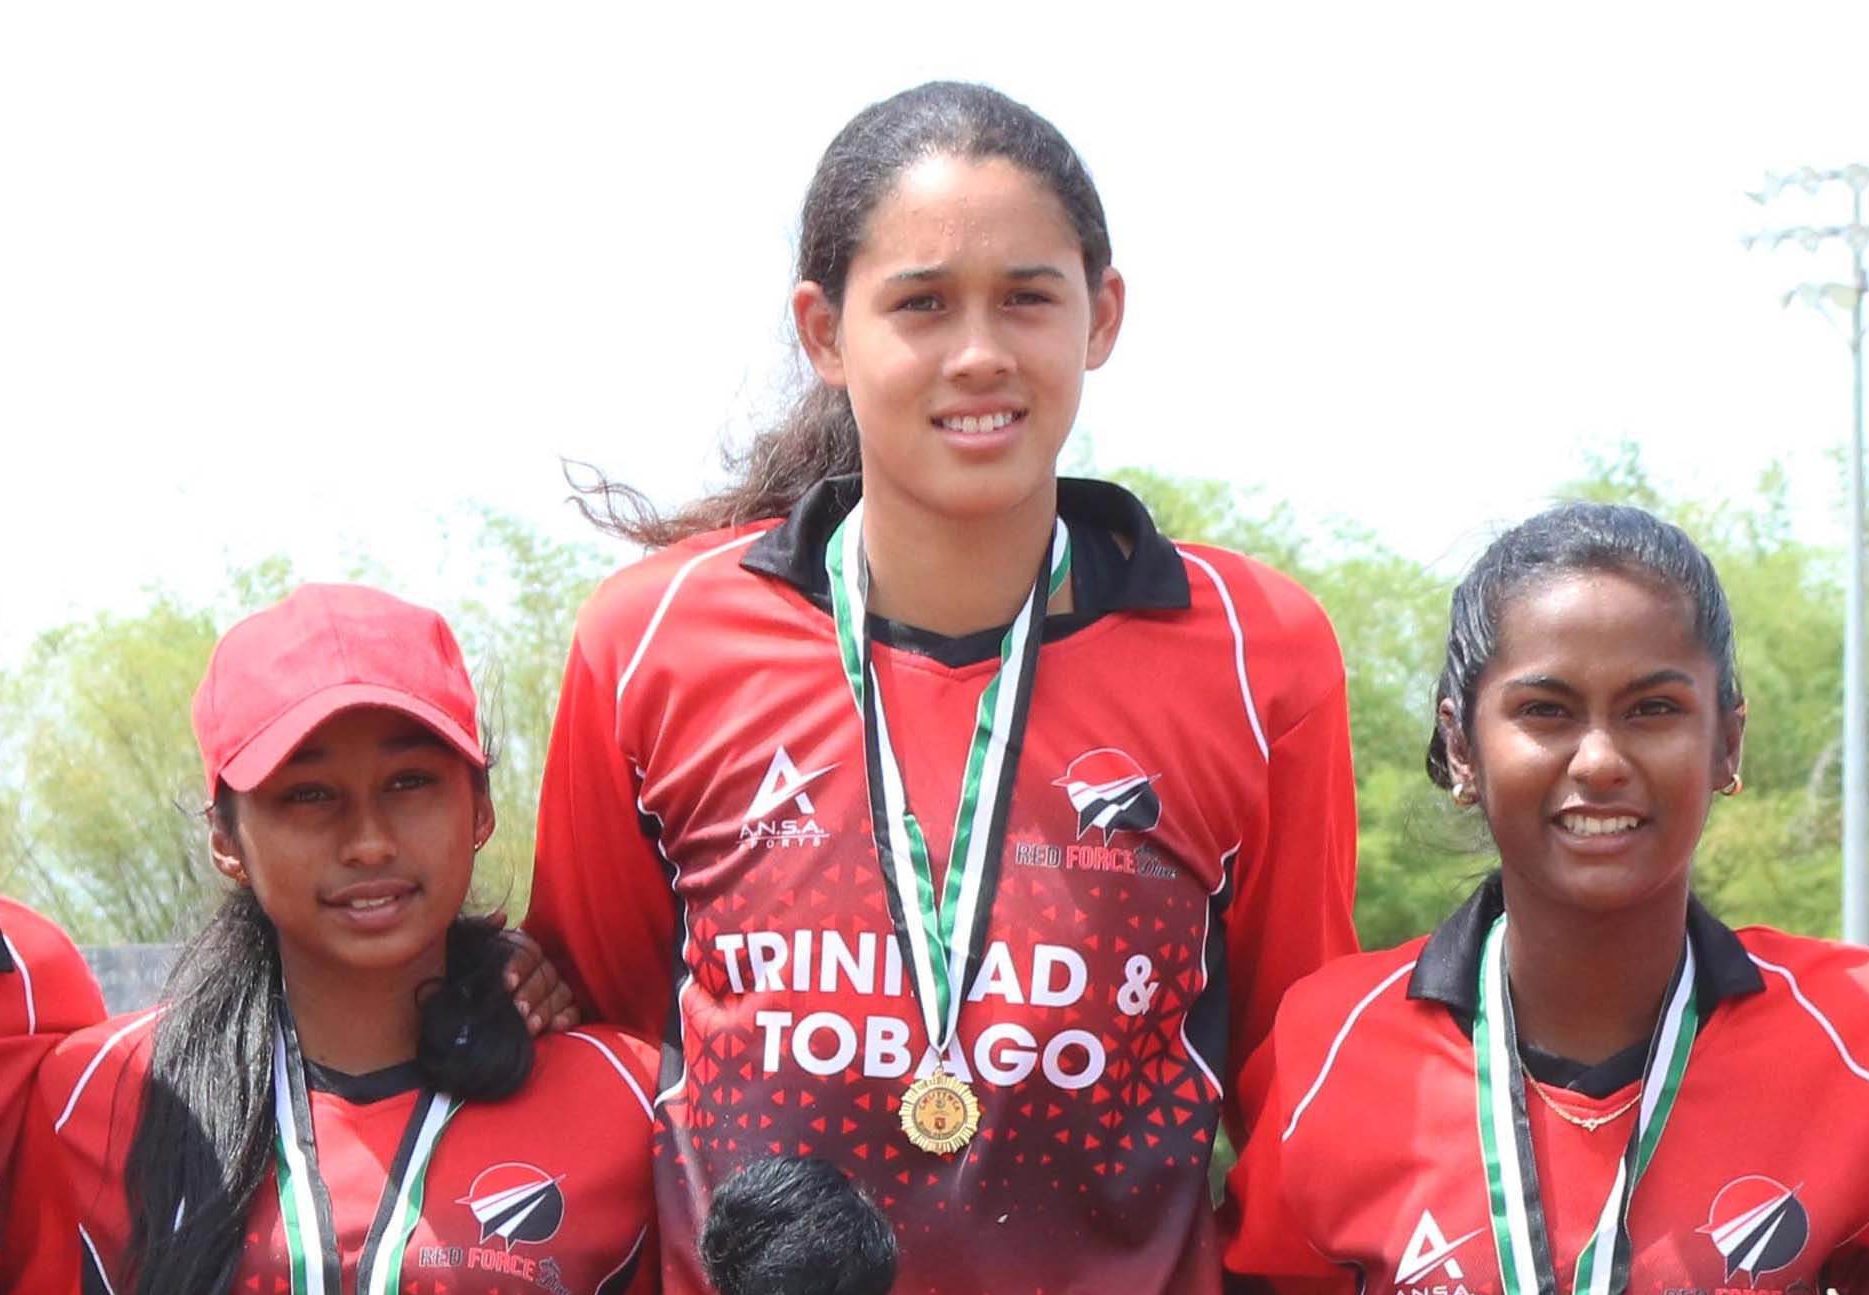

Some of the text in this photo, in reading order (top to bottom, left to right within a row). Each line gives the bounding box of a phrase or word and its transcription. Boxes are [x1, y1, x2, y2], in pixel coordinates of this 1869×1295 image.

[1015, 842, 1061, 868] RED
[1066, 844, 1136, 874] FORCE
[1117, 954, 1160, 1016] &
[419, 1246, 463, 1267] RED
[467, 1247, 536, 1282] FORCE
